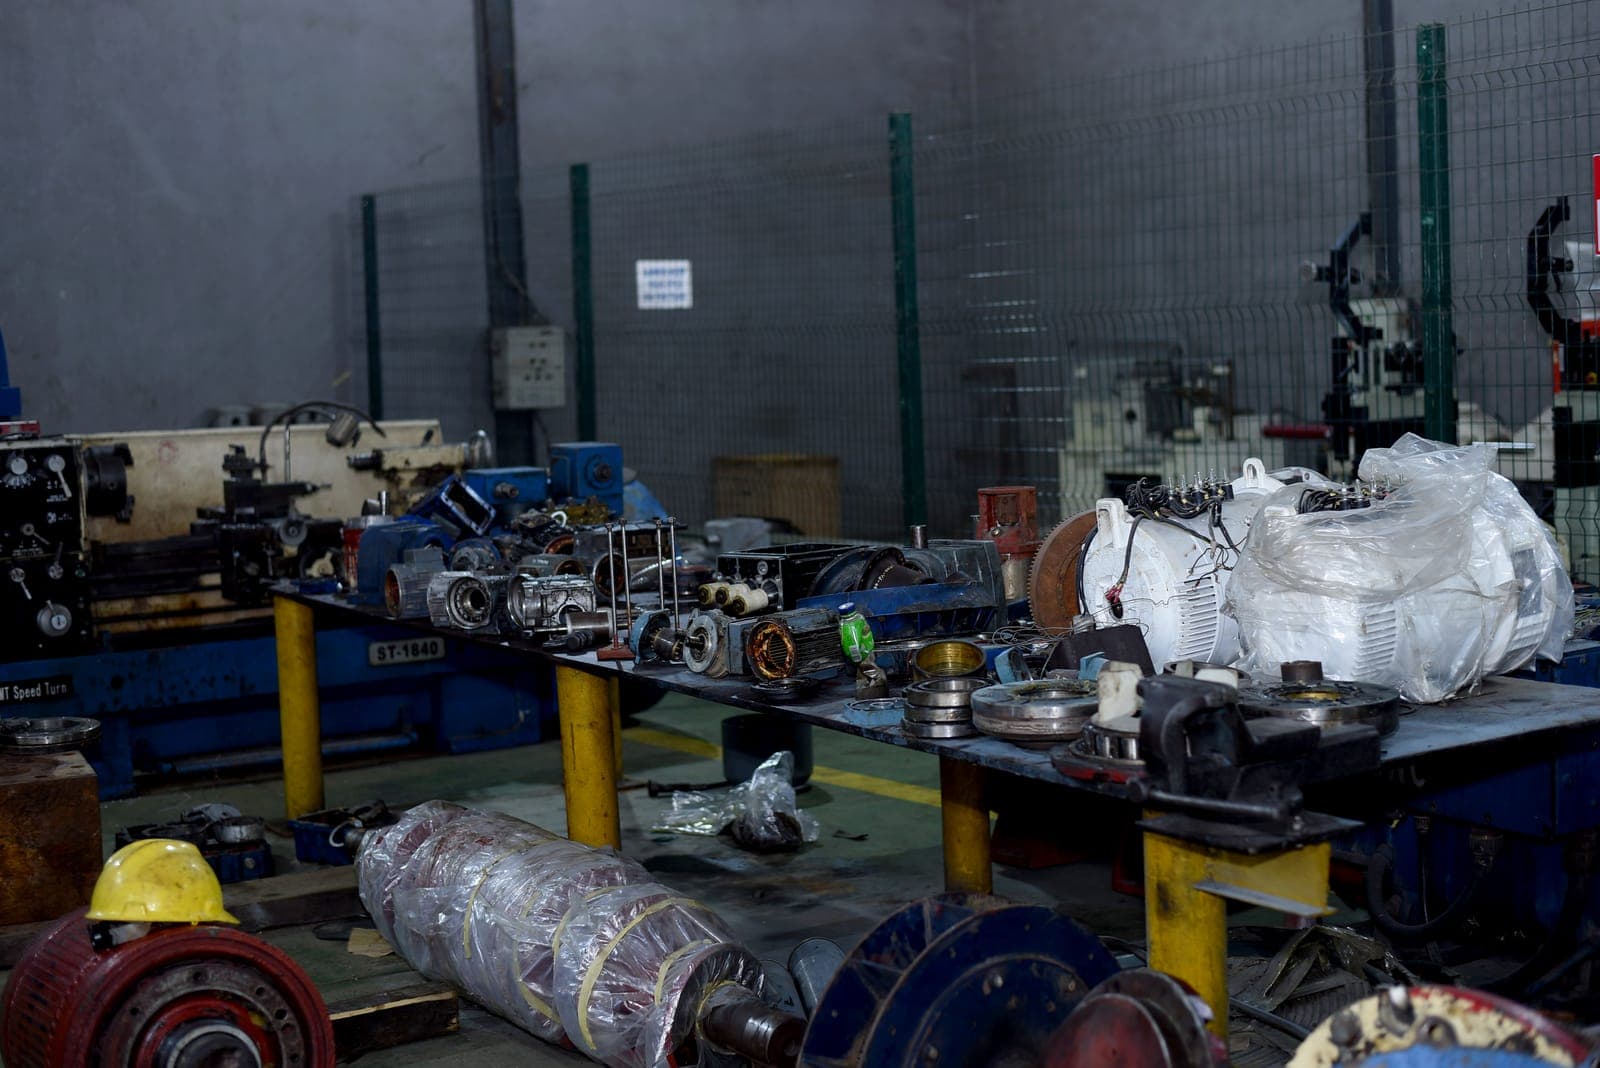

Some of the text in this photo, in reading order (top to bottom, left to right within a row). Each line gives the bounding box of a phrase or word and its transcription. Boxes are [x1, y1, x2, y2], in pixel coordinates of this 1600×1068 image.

[377, 641, 438, 661] ST-1840
[13, 683, 41, 701] Speed
[44, 681, 67, 696] Turn
